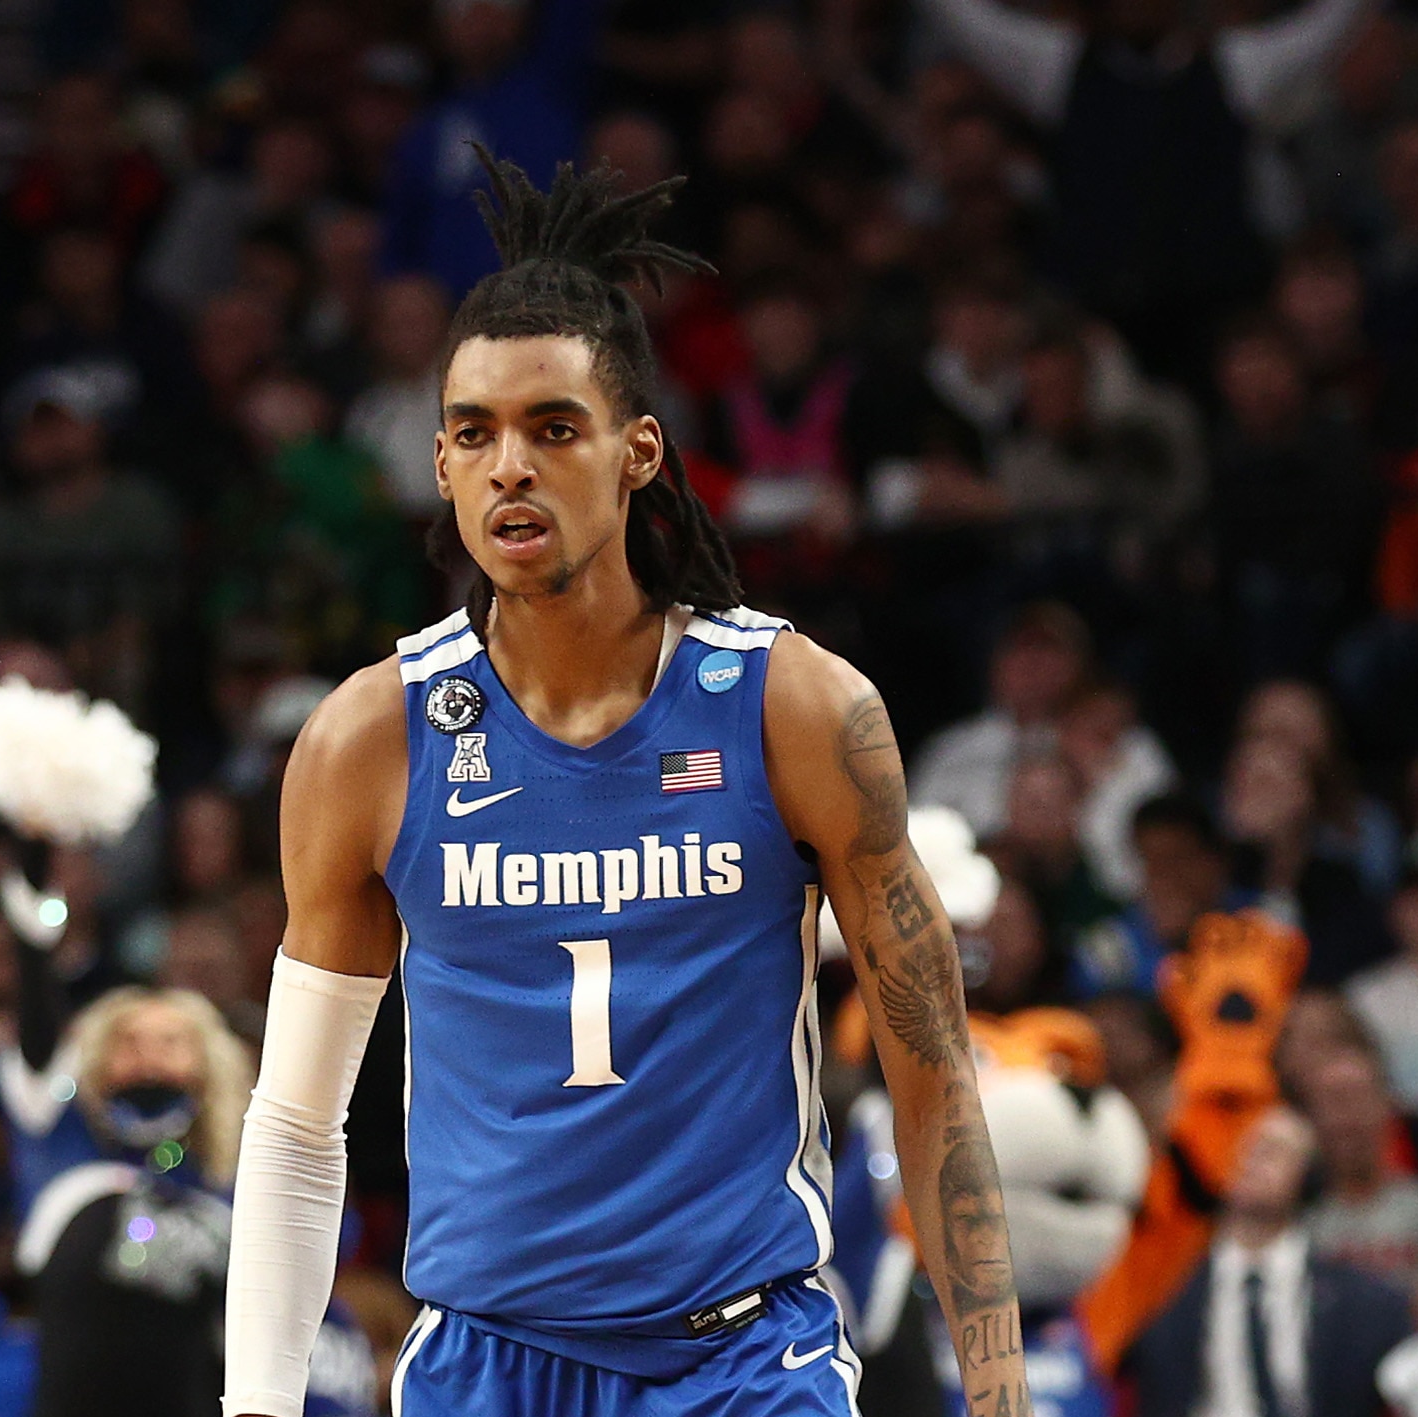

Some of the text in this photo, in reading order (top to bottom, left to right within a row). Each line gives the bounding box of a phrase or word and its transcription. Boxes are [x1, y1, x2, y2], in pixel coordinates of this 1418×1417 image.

[703, 666, 740, 684] NCAA
[439, 833, 743, 914] Memphis
[557, 938, 626, 1088] 1
